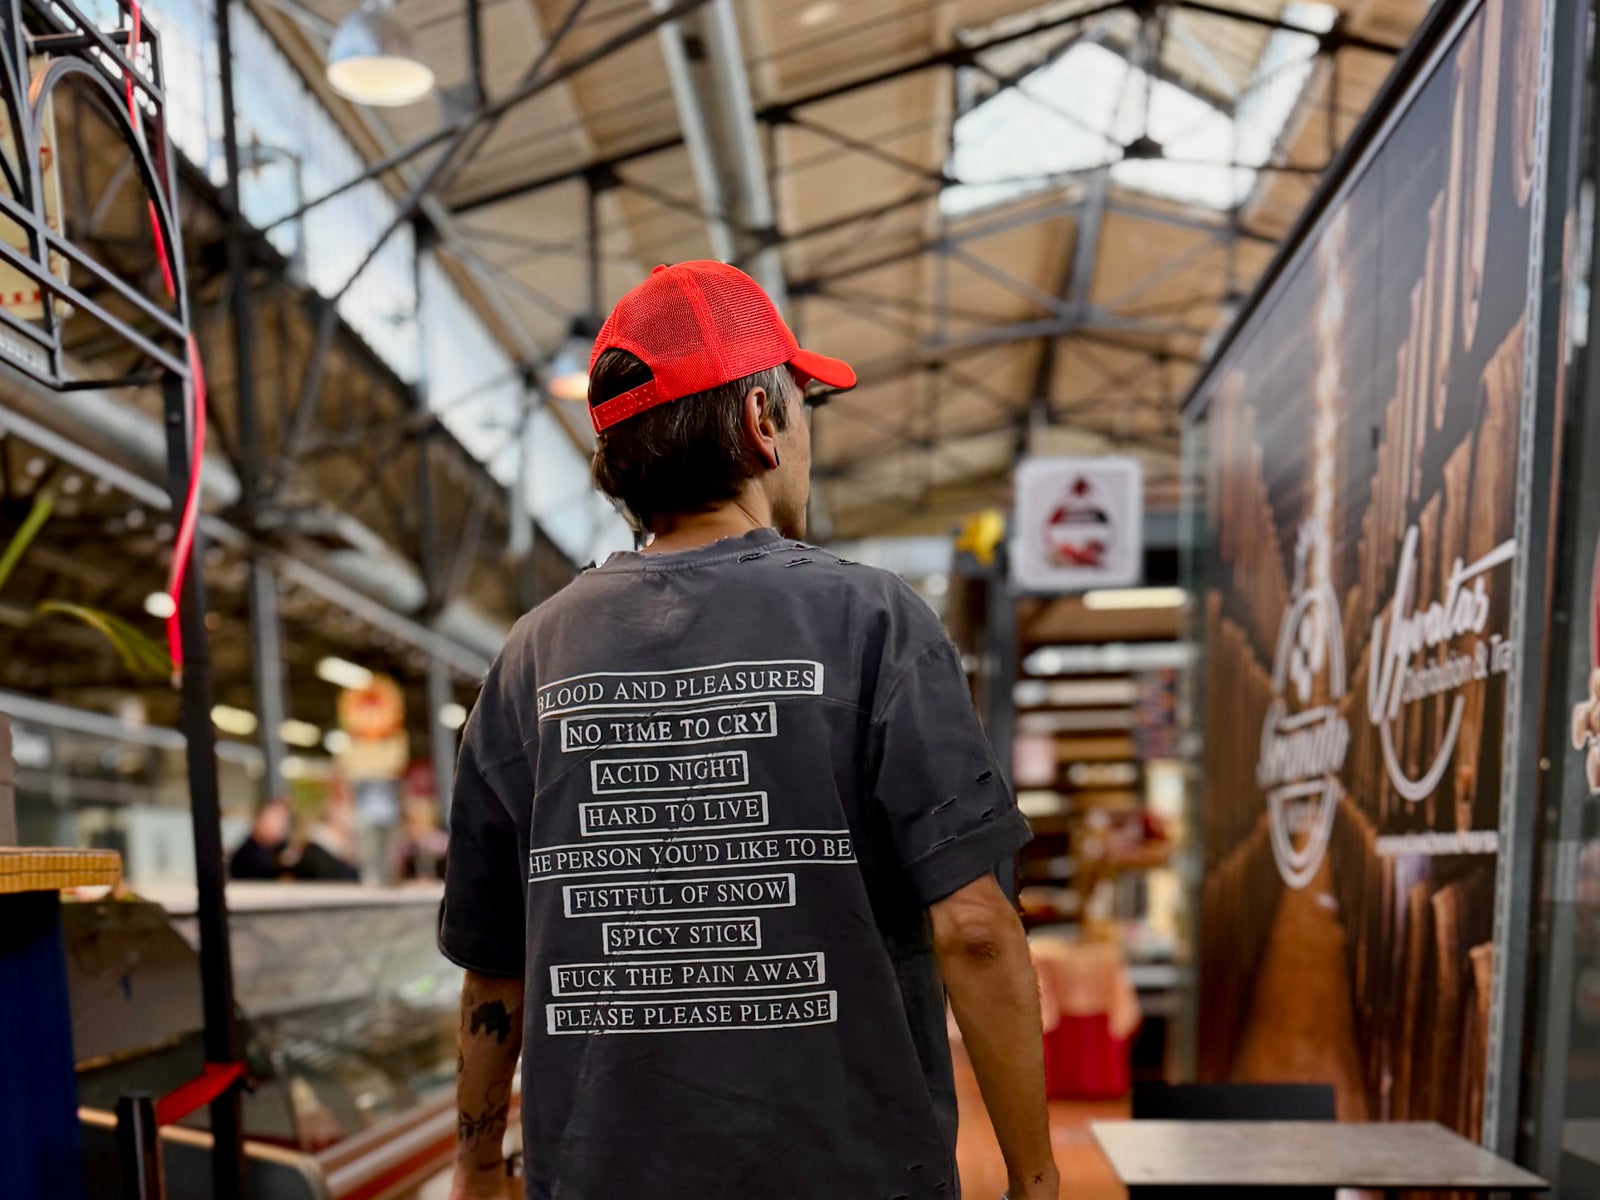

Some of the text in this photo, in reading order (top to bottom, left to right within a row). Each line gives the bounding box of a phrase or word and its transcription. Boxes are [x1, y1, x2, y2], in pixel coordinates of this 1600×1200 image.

[538, 670, 815, 714] BLOOD AND PLEASURES
[568, 710, 769, 746] NO TIME TO CRY
[600, 757, 741, 785] ACID NIGHT
[588, 799, 761, 827] HARD TO LIVE
[529, 838, 851, 874] HE PERSON YOU'D LIKE TO BE
[575, 880, 787, 909] FISTFUL OF SNOW
[610, 923, 756, 947] SPICY STICK
[559, 959, 817, 988] FUCK THE PAIN AWAY
[555, 999, 830, 1027] PLEASE PLEASE PLEASE
